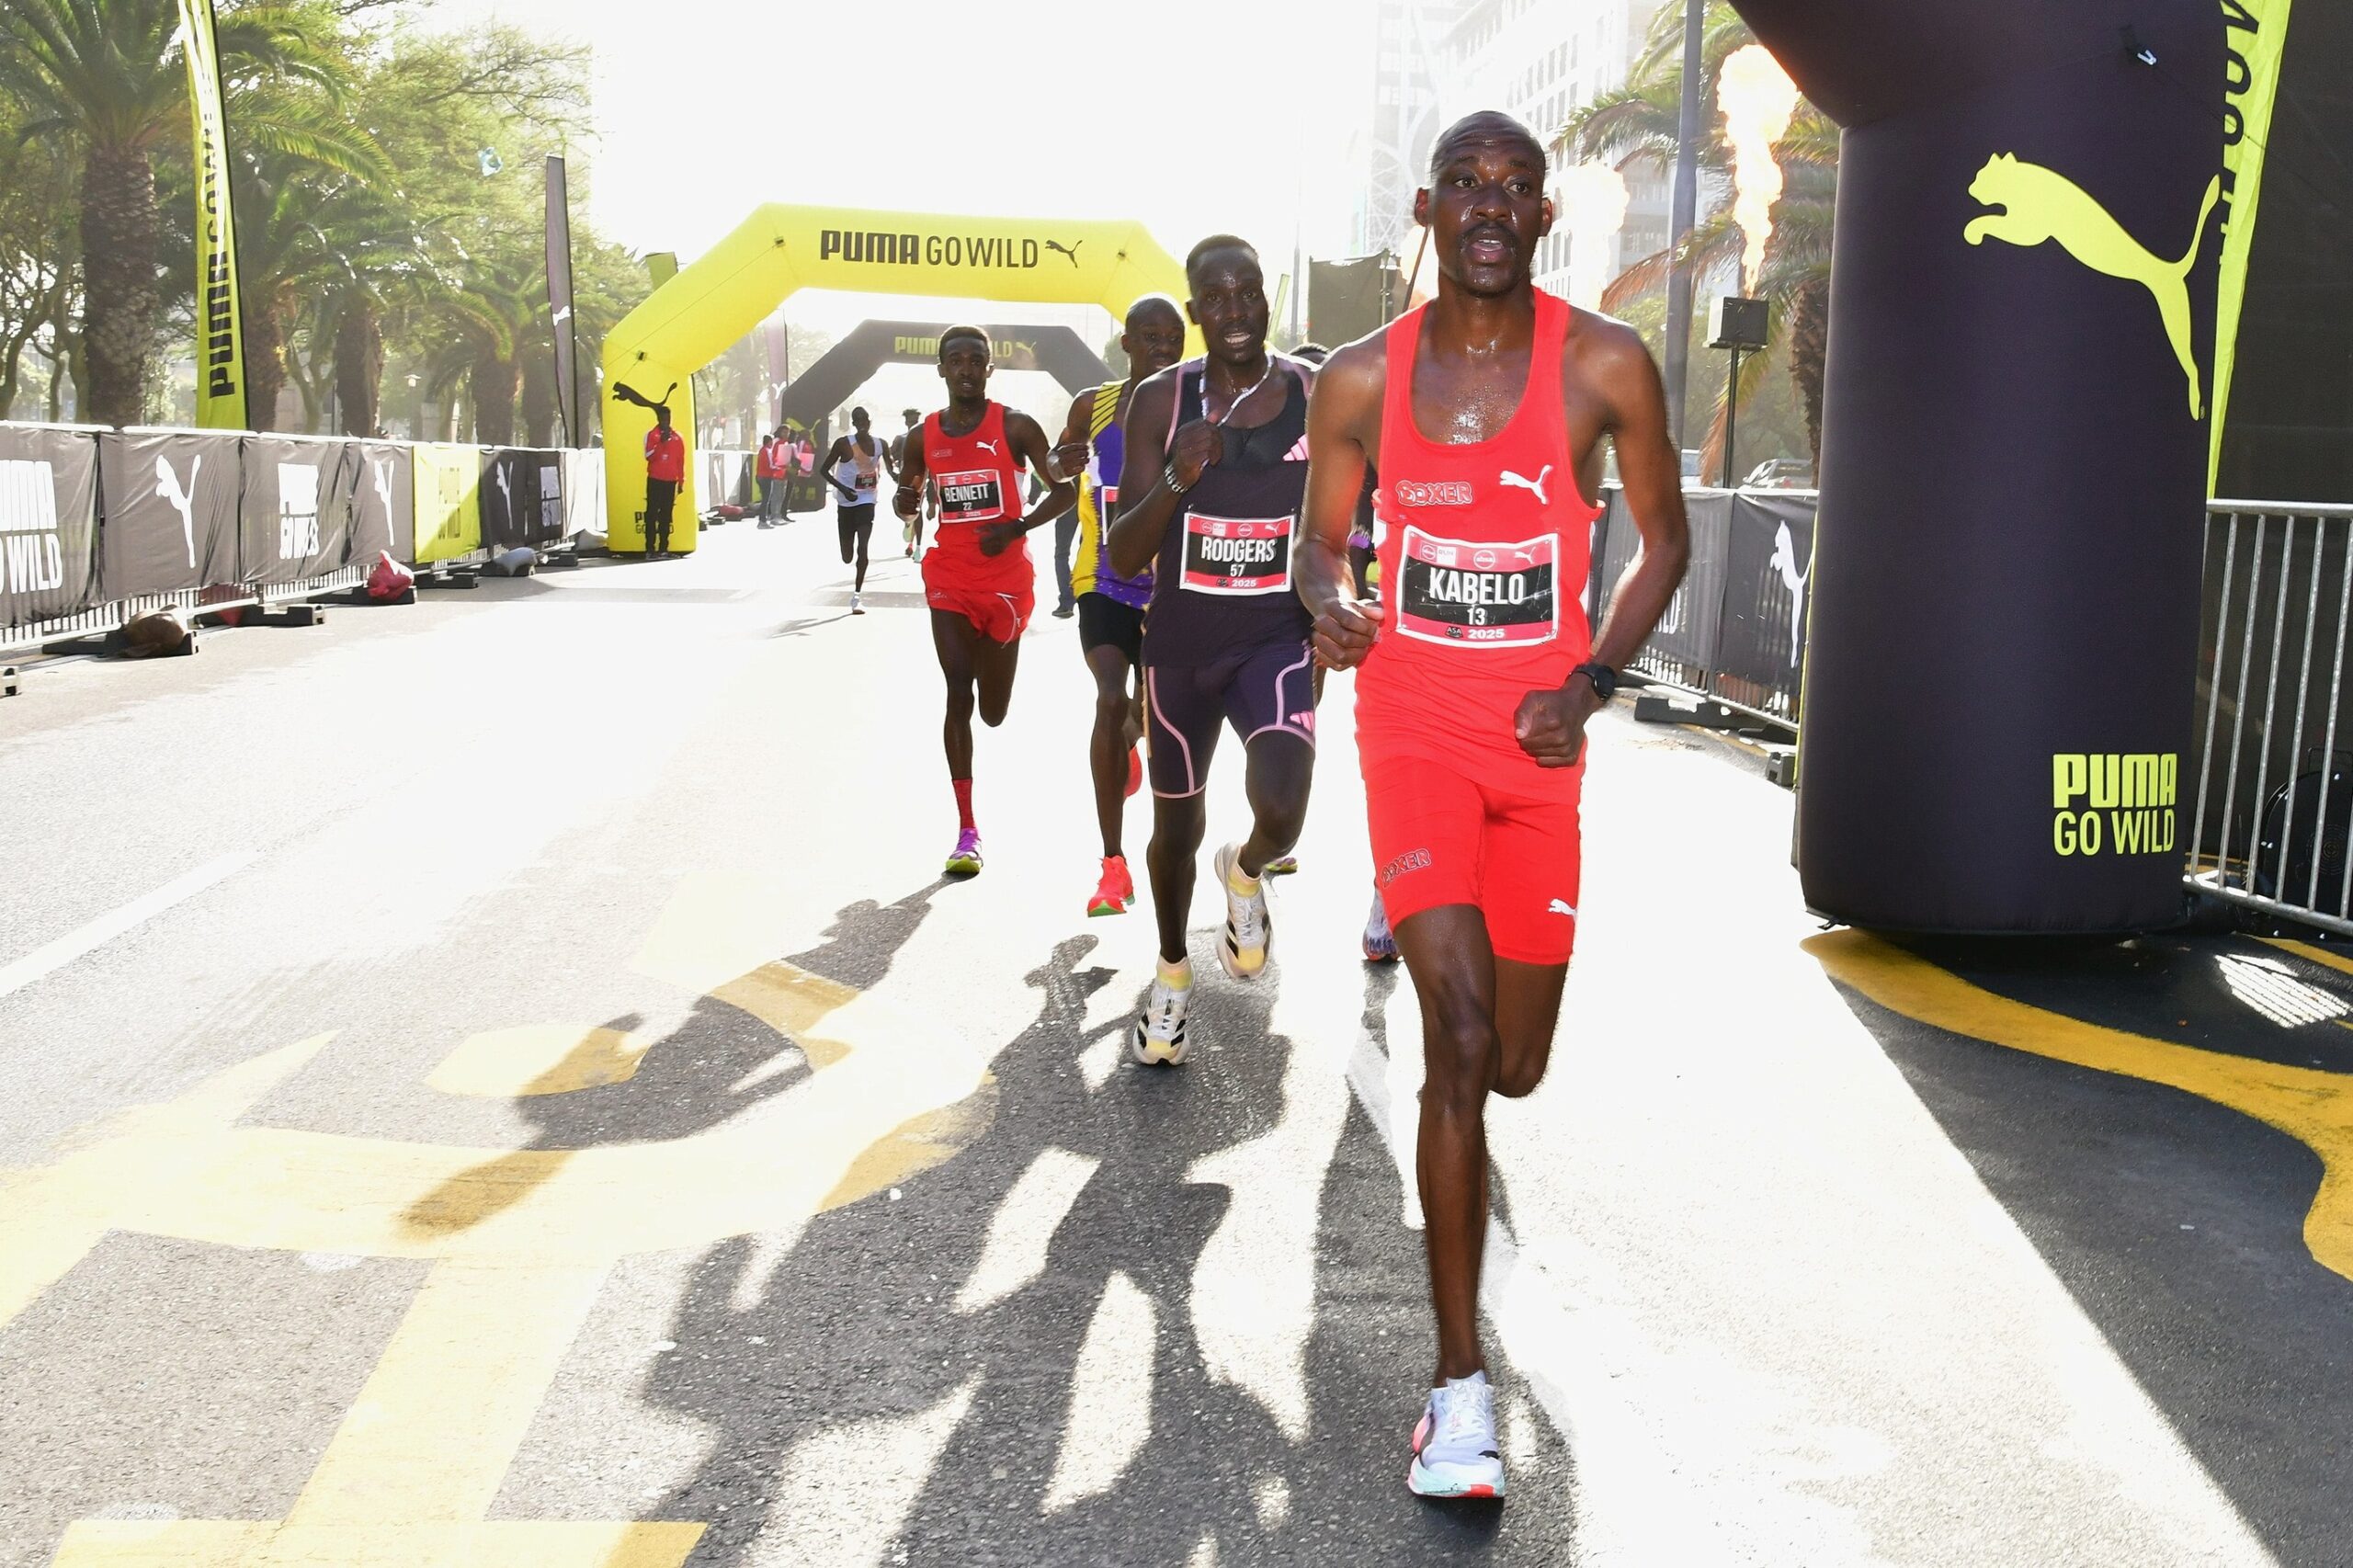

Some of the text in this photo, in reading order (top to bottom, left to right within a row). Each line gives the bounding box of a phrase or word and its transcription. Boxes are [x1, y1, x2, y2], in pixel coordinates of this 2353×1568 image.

[820, 230, 920, 265] PUMA
[208, 251, 235, 399] PUMA
[943, 483, 990, 503] BENNETT
[962, 502, 972, 511] 22
[1200, 536, 1277, 562] RODGERS
[6, 533, 63, 595] WILD
[1230, 563, 1246, 577] 57
[1232, 579, 1256, 587] 2025
[1428, 567, 1527, 605] KABELO
[1467, 608, 1487, 626] 13
[1468, 628, 1506, 640] 2025
[2052, 754, 2177, 809] PUMA
[2054, 809, 2175, 856] GO WILD
